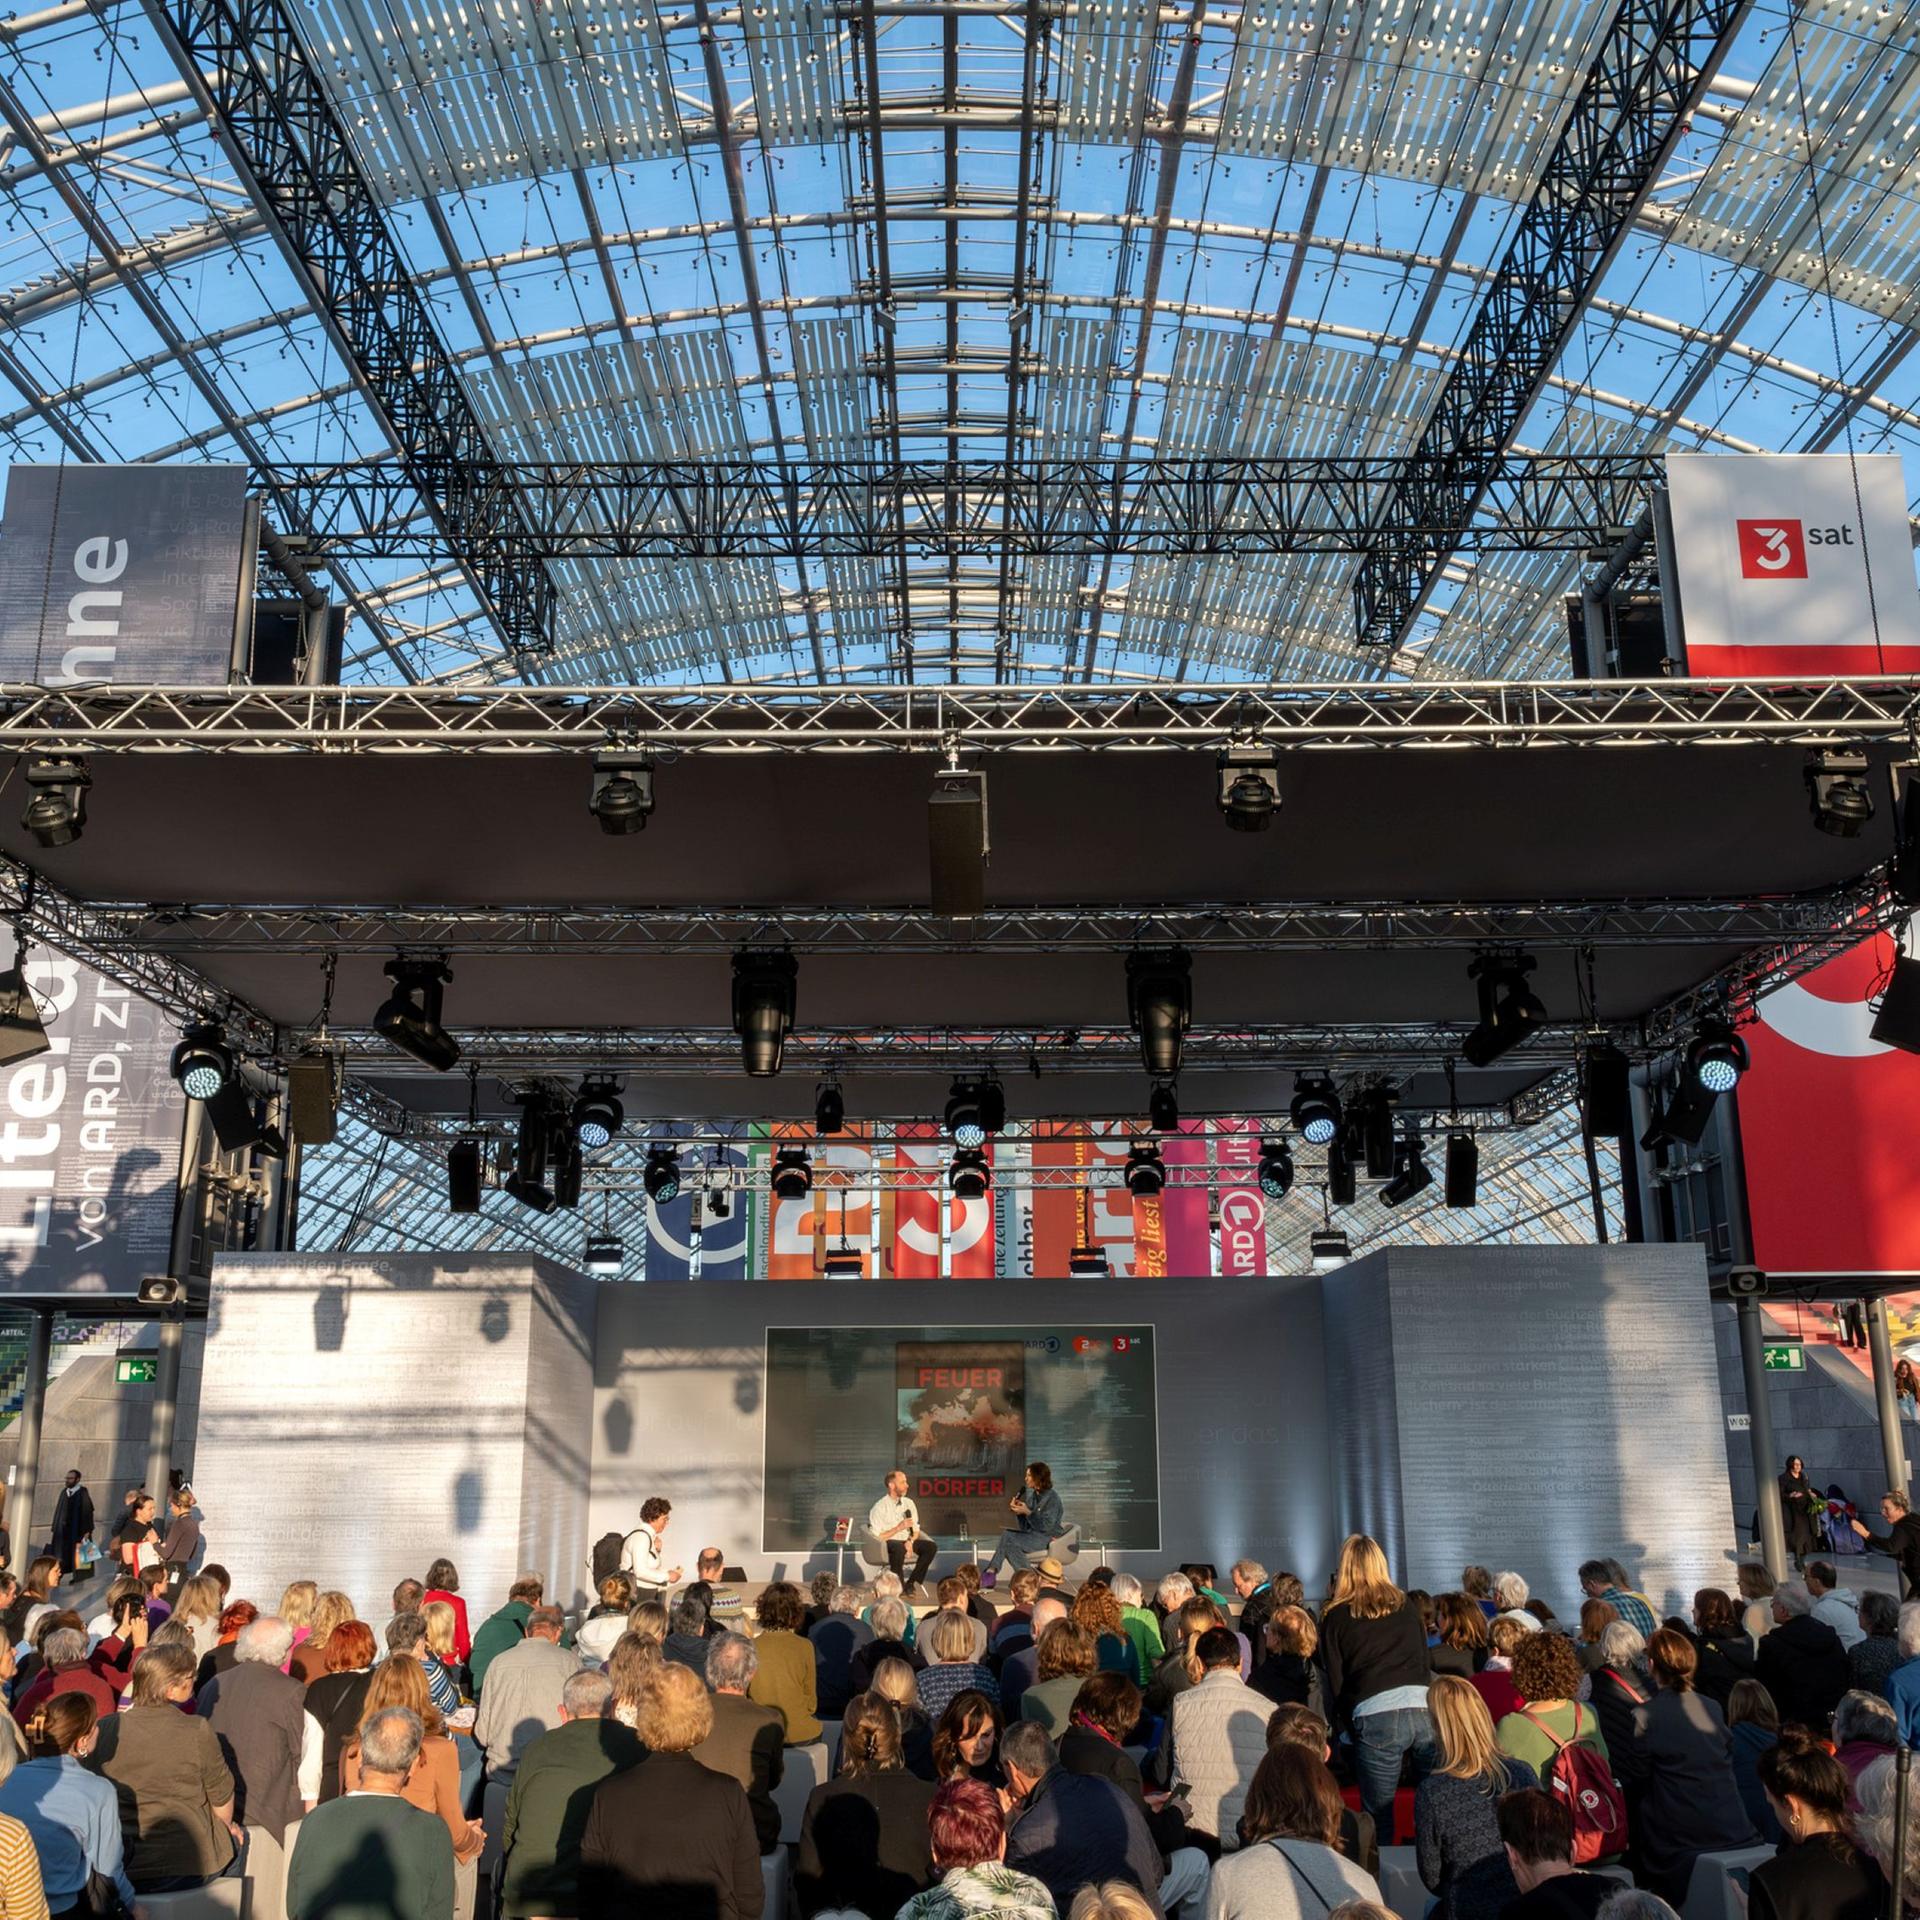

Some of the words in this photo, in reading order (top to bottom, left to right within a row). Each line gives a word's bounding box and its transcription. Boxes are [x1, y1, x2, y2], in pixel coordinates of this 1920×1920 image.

[1753, 527, 1791, 571] 3
[1808, 524, 1854, 546] sat
[80, 1041, 132, 1151] ARD,
[76, 1158, 110, 1252] von
[1141, 1200, 1161, 1242] liest
[919, 1368, 1003, 1388] FEUER
[919, 1477, 1004, 1497] DÖRFER
